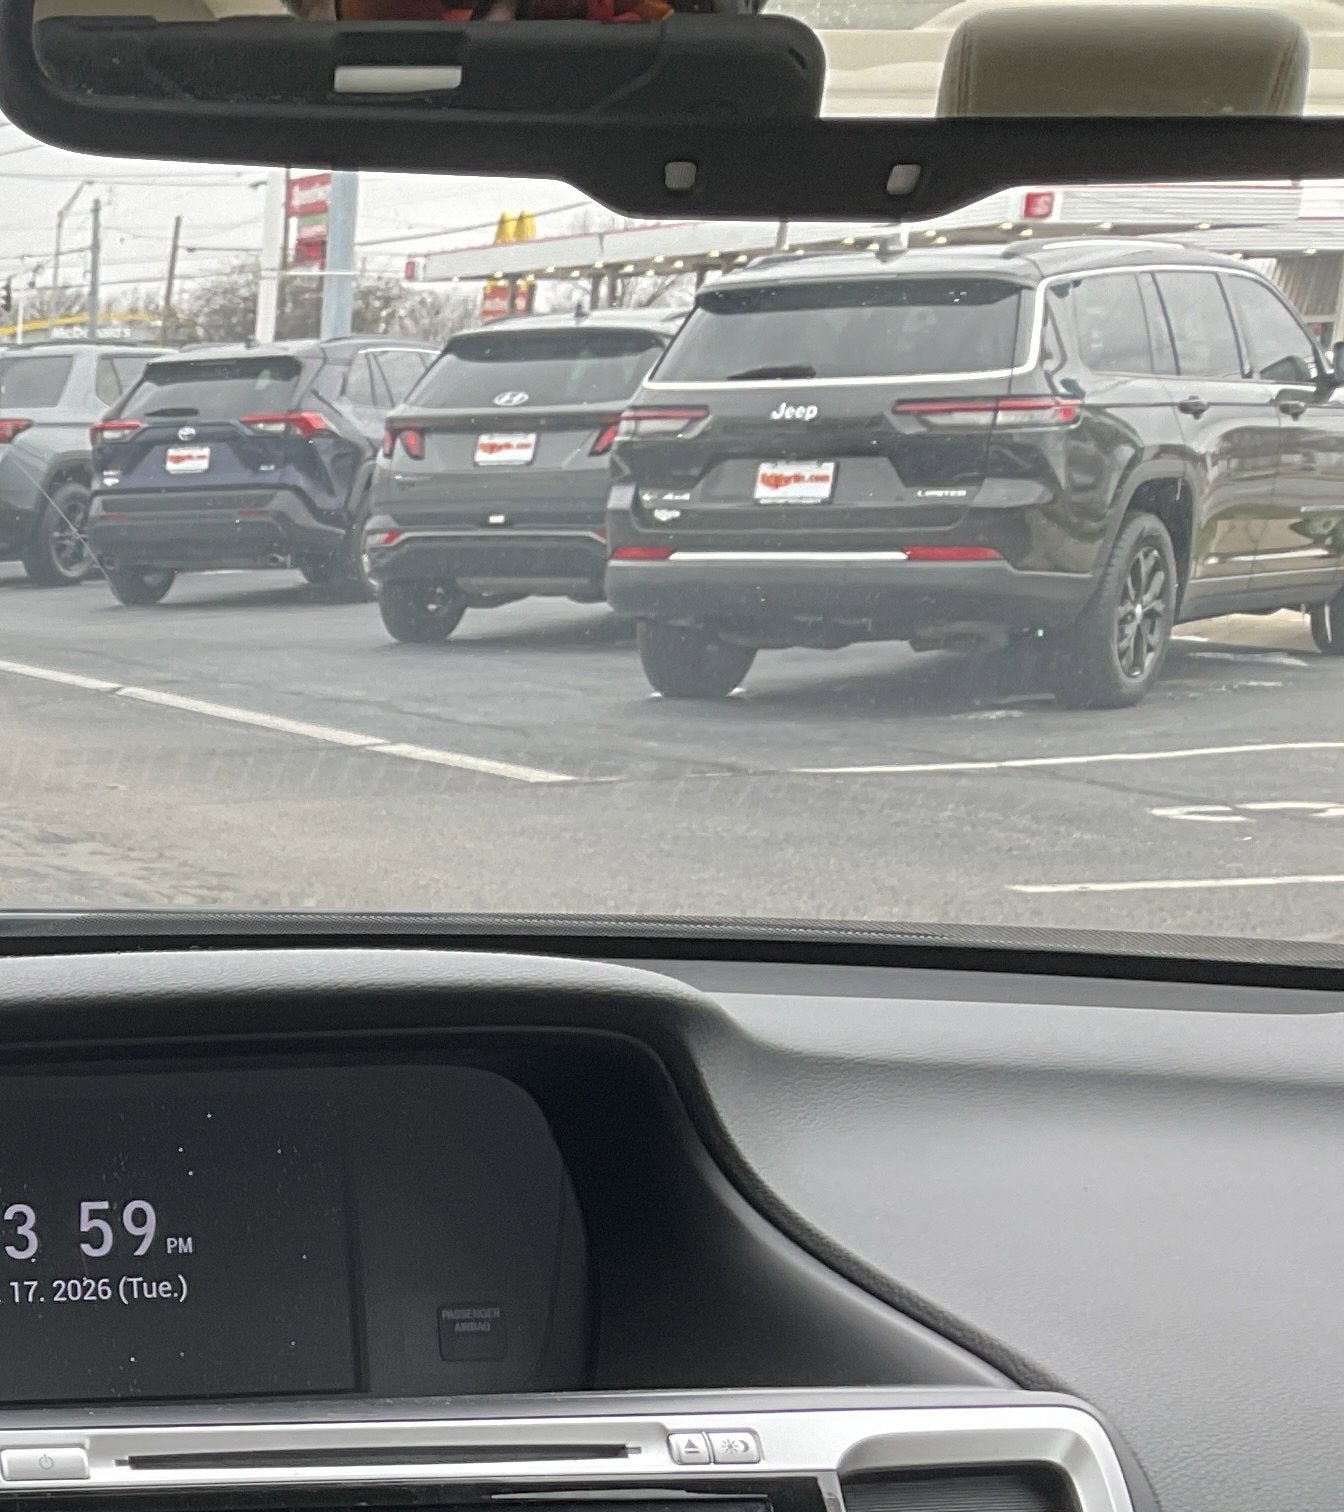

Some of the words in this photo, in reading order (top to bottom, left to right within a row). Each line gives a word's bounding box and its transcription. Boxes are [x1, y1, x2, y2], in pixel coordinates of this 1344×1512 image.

[770, 401, 818, 421] Jeep
[3, 1203, 39, 1260] 3
[79, 1200, 157, 1257] 59
[166, 1237, 193, 1254] PM
[52, 1278, 112, 1302] 2026
[118, 1274, 188, 1305] (Tue.)
